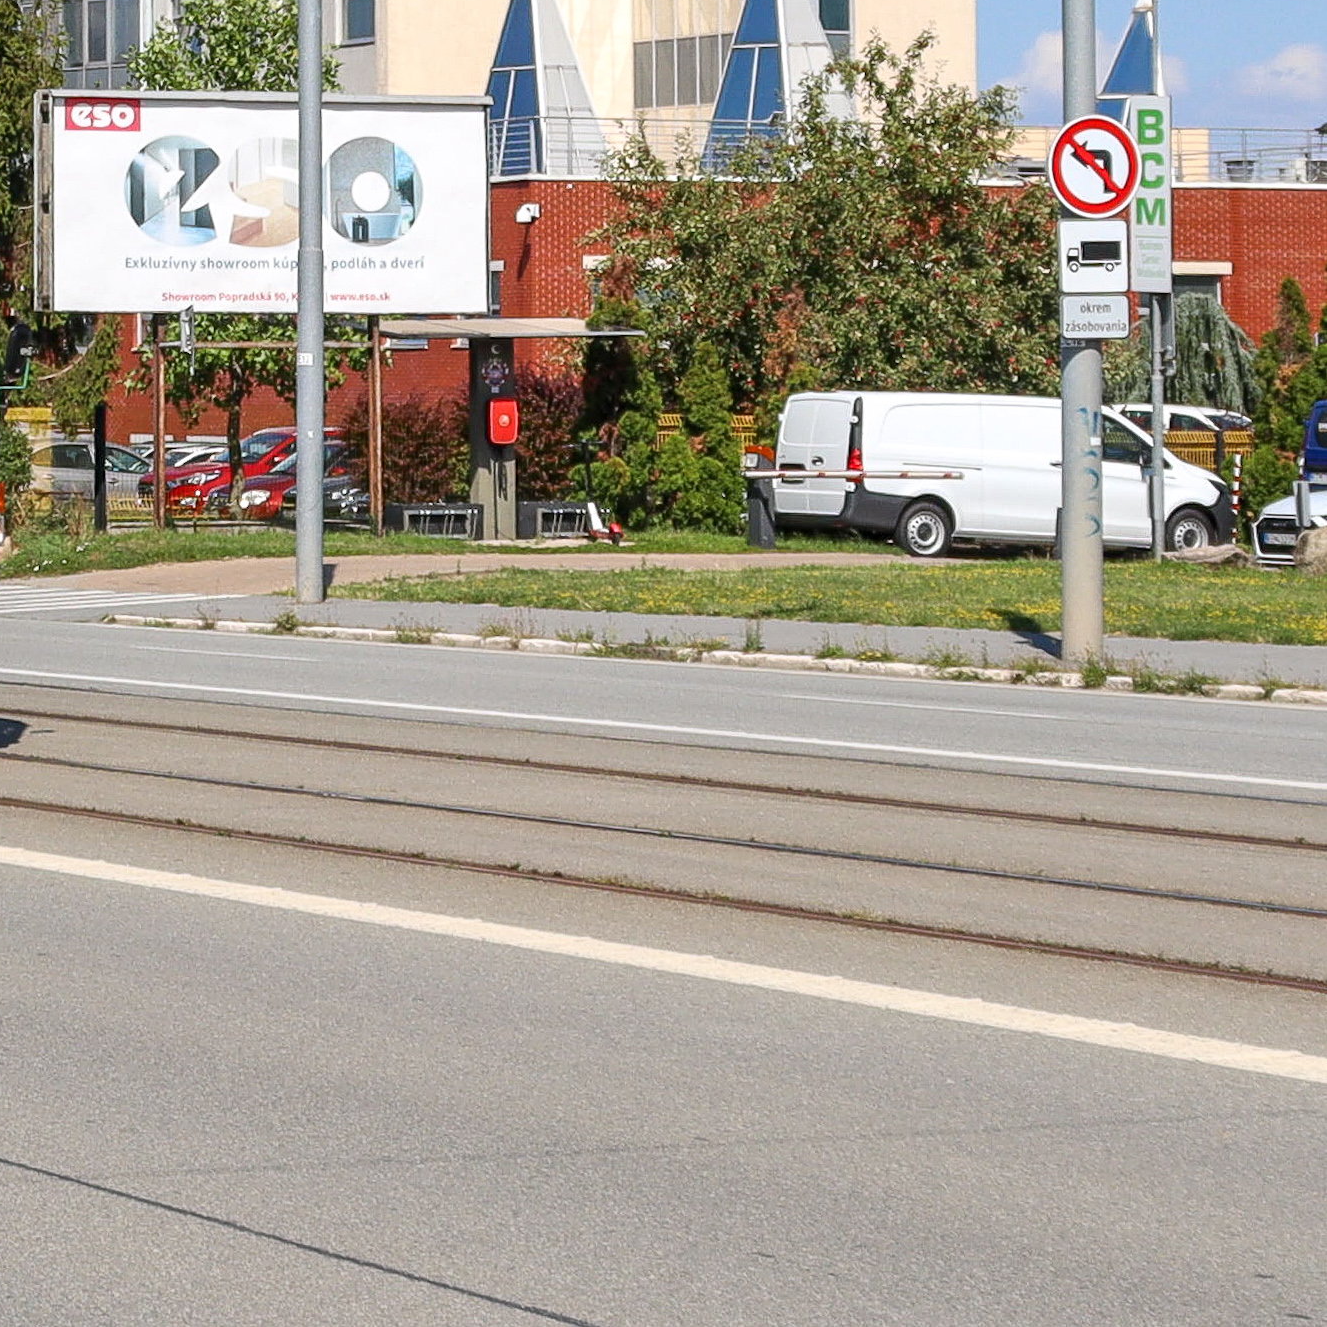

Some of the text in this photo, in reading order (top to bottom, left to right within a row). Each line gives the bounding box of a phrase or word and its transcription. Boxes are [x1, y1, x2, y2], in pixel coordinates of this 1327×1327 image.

[71, 103, 135, 129] eso
[1136, 109, 1165, 226] BCM
[125, 257, 196, 272] Exkluzívny
[201, 257, 269, 270] showroom
[331, 257, 376, 272] podláh
[379, 260, 387, 270] a
[391, 256, 425, 270] dverí
[162, 292, 216, 302] Showroom
[219, 292, 271, 304] Popradská
[330, 292, 391, 302] www.eso.sk
[1080, 302, 1112, 314] okrem
[1065, 320, 1127, 333] zásobovania
